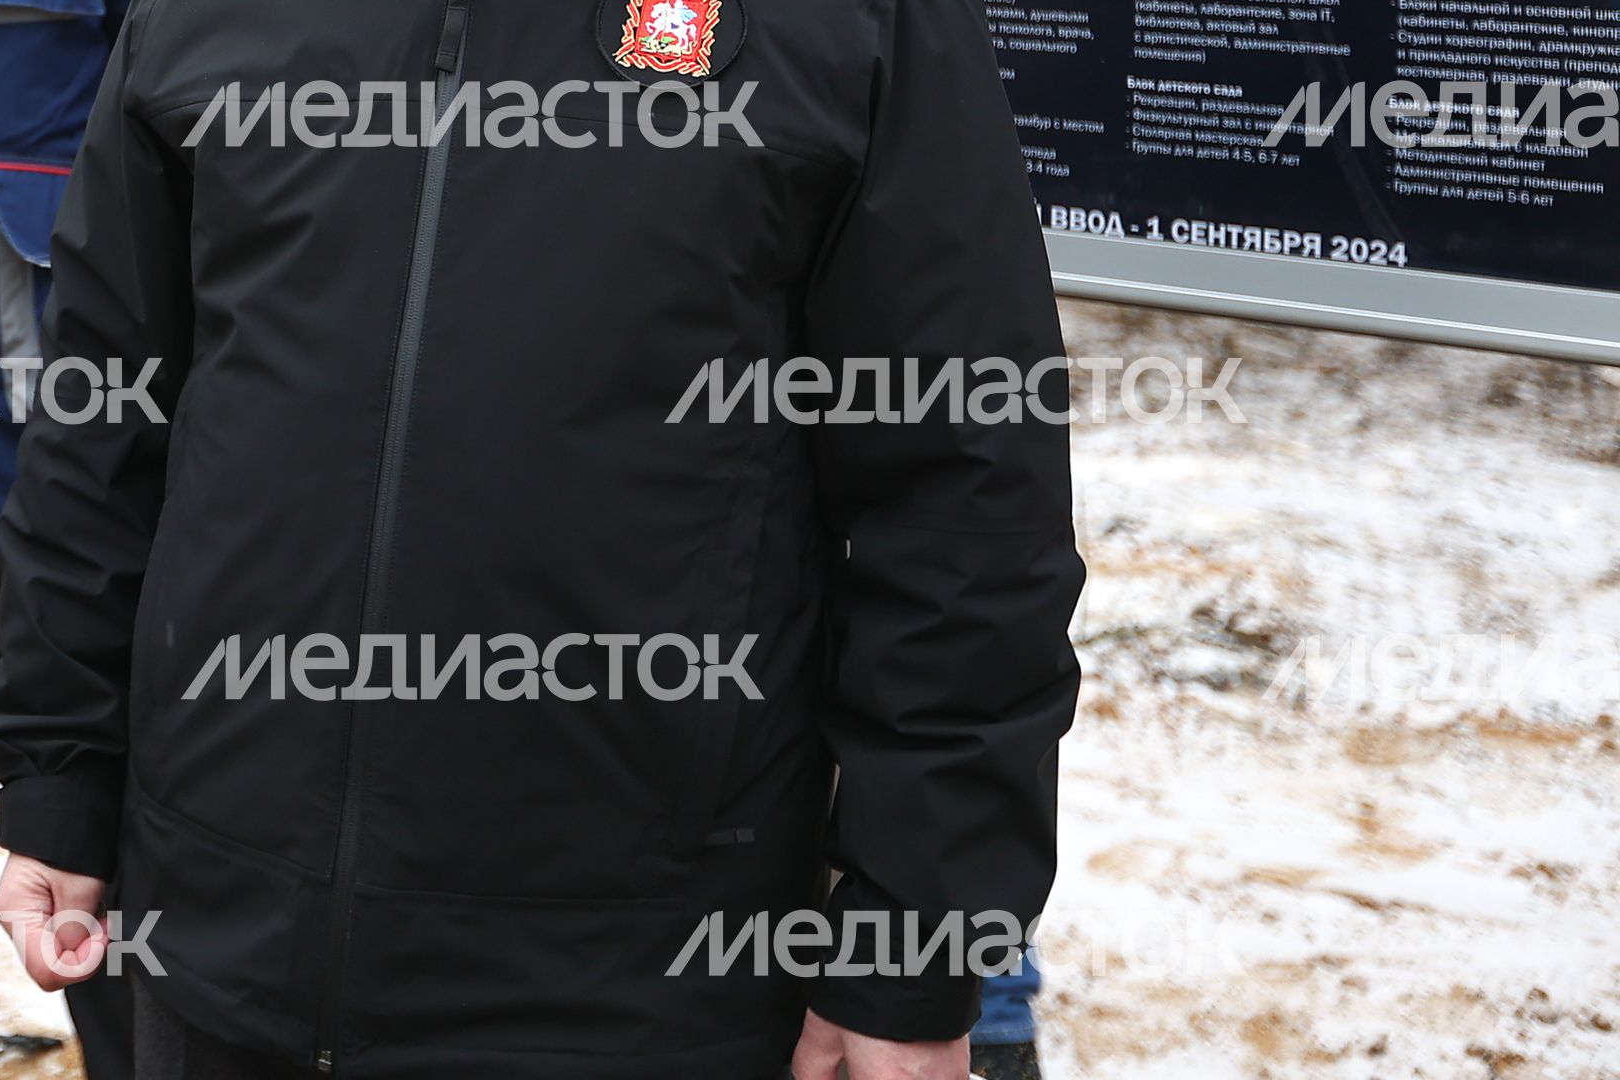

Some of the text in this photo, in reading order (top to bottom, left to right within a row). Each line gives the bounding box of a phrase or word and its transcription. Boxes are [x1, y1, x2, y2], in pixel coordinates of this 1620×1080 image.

[1513, 3, 1522, 16] и
[1127, 74, 1156, 91] Блок
[1157, 78, 1211, 95] детского
[1050, 204, 1408, 268] ВВОД 1 СЕНТЯБРЯ 2024
